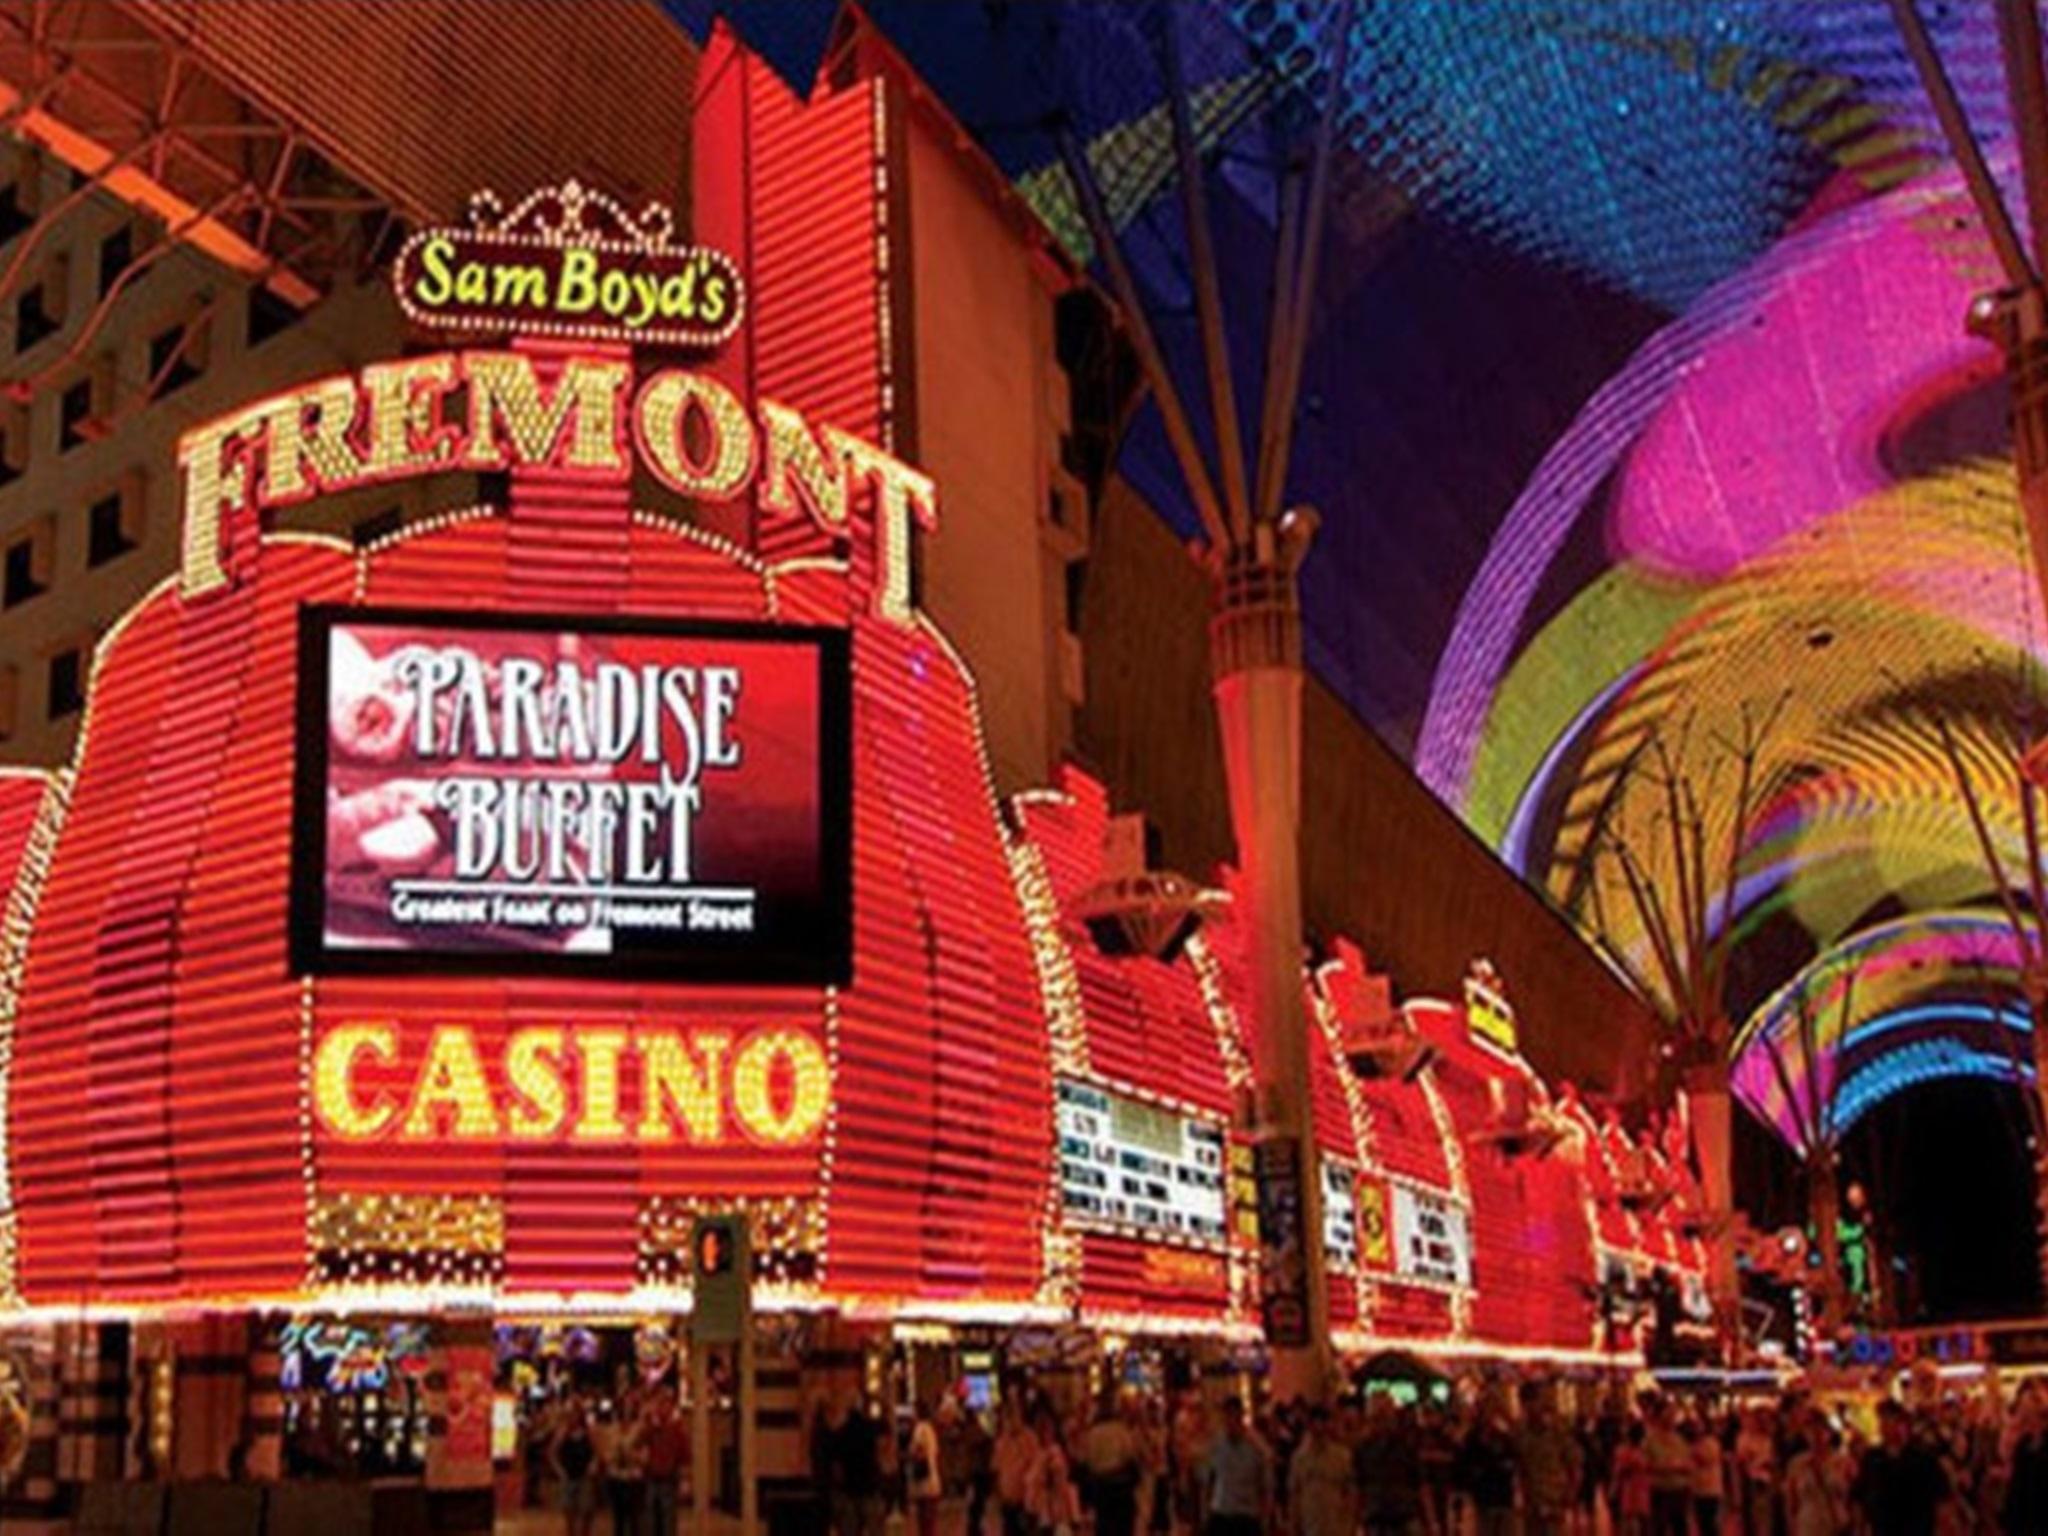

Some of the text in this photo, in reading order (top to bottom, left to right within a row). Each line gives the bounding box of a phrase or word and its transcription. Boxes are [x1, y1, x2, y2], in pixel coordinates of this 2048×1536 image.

[415, 238, 727, 327] Sam Boyd's
[177, 351, 937, 622] FREMONT
[396, 650, 742, 792] PARADISE
[432, 775, 700, 884] BUFFET
[391, 893, 487, 922] Greatest
[554, 900, 586, 925] on
[687, 900, 754, 930] Street
[311, 1020, 834, 1144] CASINO
